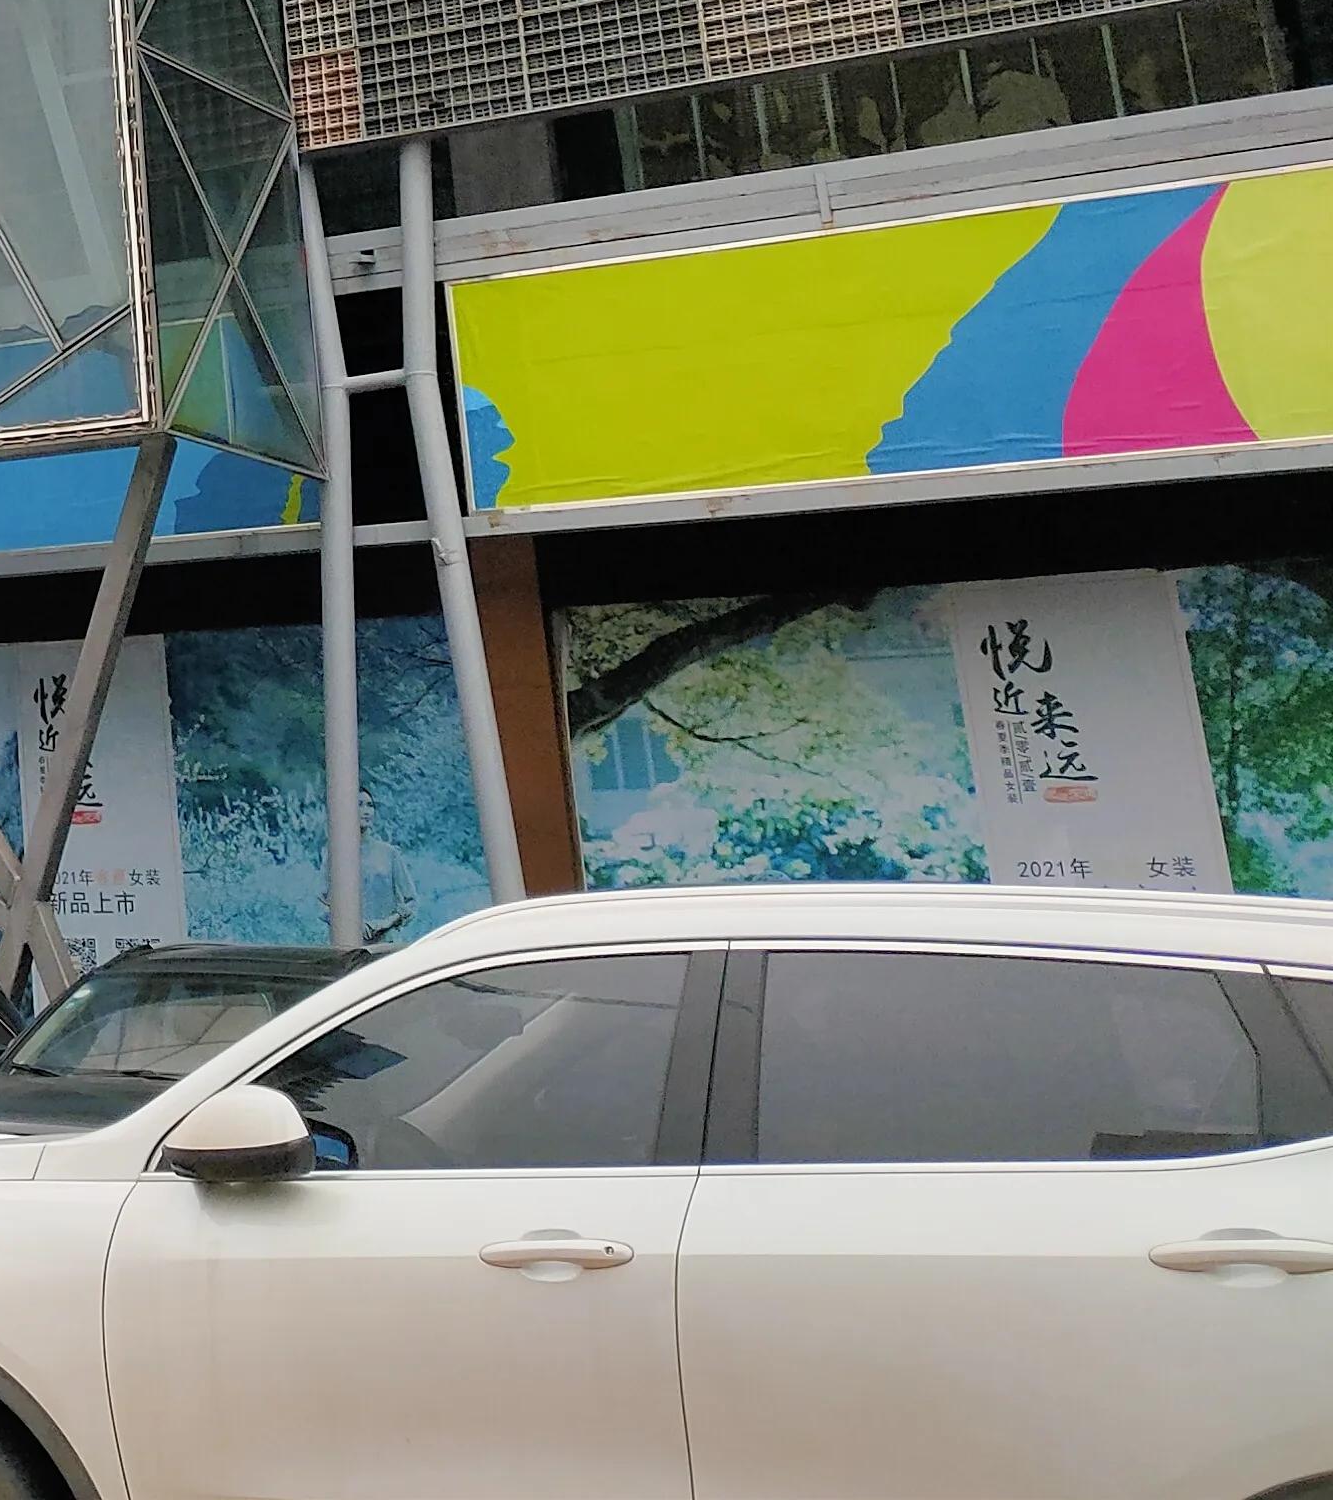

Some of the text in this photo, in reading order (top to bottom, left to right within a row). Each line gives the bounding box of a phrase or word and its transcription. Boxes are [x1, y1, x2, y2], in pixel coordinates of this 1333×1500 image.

[1017, 855, 1197, 880] 2021年 女装
[50, 890, 136, 916] 新品上市
